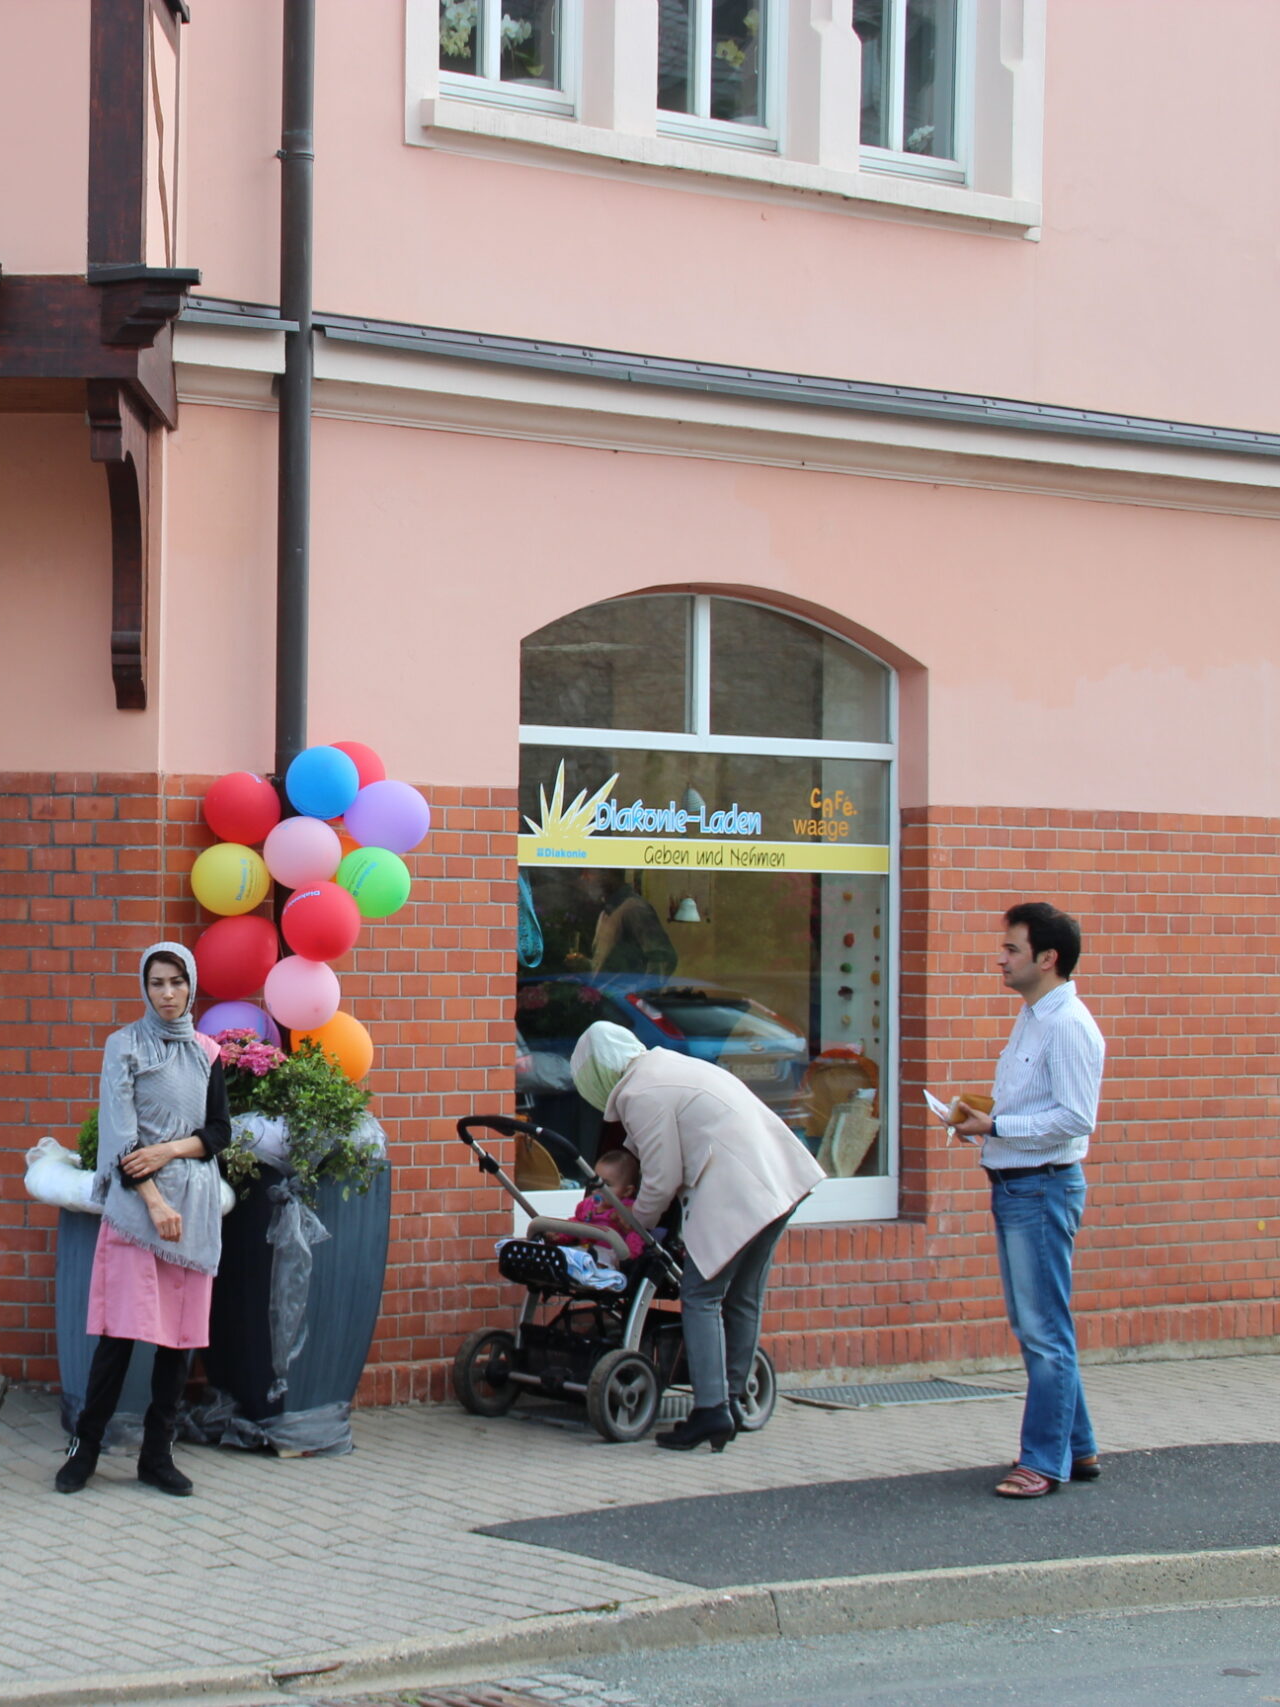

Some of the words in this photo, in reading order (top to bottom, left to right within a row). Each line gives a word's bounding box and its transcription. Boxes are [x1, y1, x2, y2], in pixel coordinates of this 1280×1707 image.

[595, 798, 762, 835] Diakonie-Laden
[792, 818, 850, 842] waage
[545, 848, 587, 859] Diakonie
[644, 845, 689, 865] Geben
[696, 846, 723, 865] und
[730, 847, 785, 869] Nehmen
